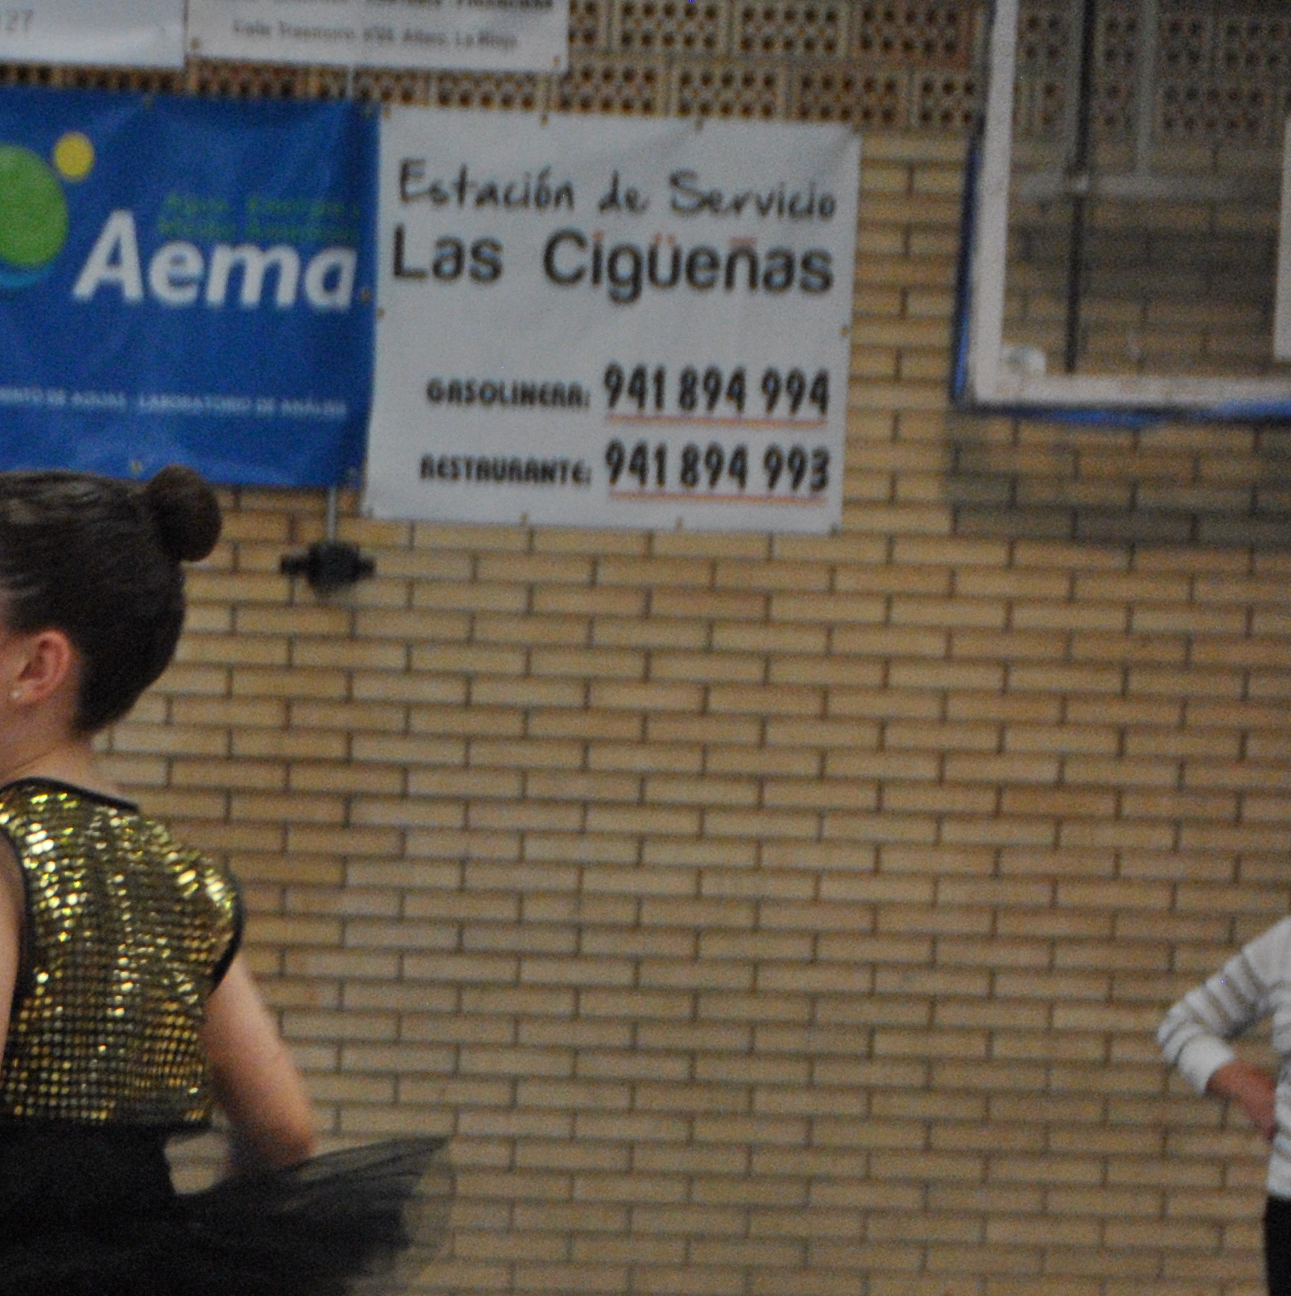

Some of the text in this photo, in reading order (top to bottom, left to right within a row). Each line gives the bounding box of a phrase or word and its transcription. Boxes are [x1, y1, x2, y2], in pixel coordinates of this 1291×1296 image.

[400, 156, 838, 220] Estación de Servicio
[72, 208, 359, 313] Aema
[393, 222, 834, 306] Las Cigüeñas
[425, 361, 830, 417] GASOLINERA: 941 894 994
[418, 438, 831, 494] RESTAURANTE: 941 894 993
